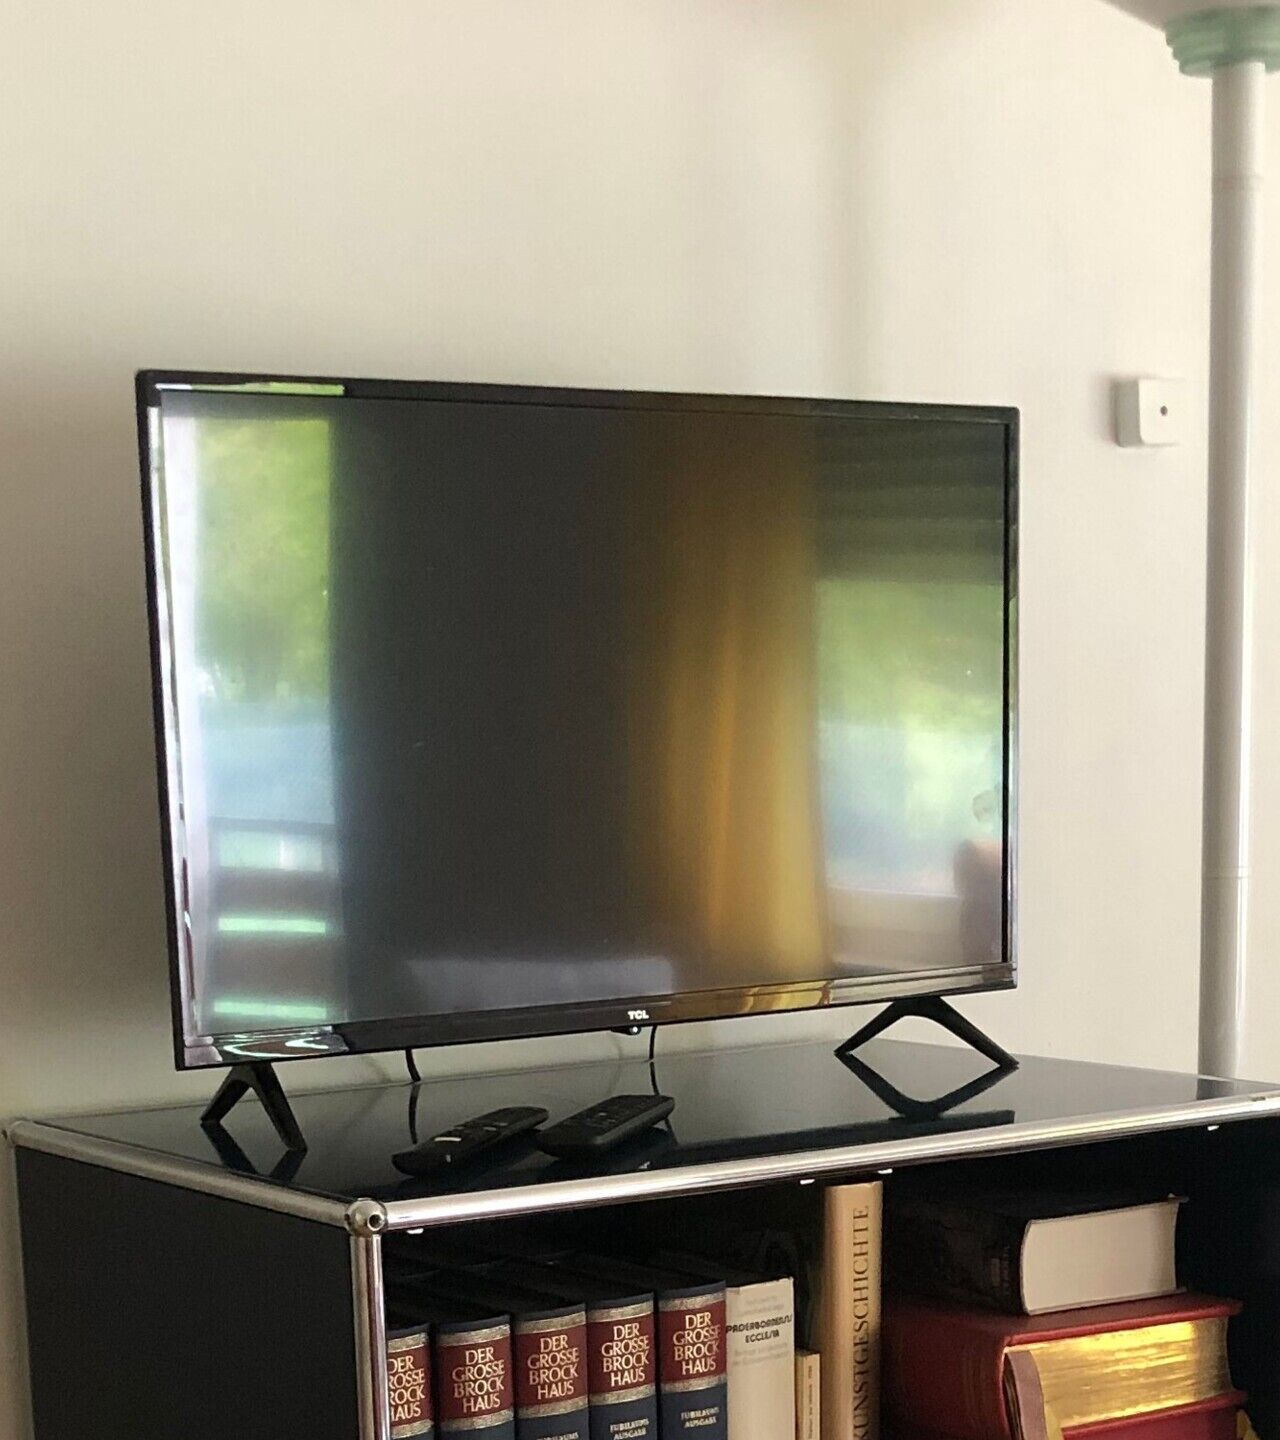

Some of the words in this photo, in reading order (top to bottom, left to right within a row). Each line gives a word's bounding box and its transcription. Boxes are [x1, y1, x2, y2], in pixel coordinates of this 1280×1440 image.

[627, 1010, 649, 1020] TCL
[684, 1311, 712, 1330] DER
[613, 1322, 640, 1340] DER
[672, 1325, 720, 1346] GROSSE
[540, 1334, 568, 1353] DER
[601, 1335, 650, 1357] GROSSE
[673, 1340, 719, 1361] BROCK
[388, 1355, 415, 1374] DER
[465, 1346, 495, 1366] DER
[527, 1347, 580, 1369] GROSSE
[602, 1350, 649, 1373] BROCK
[681, 1356, 717, 1375] HAUS
[389, 1368, 426, 1389] ROSSE
[451, 1359, 506, 1382] GROSSE
[528, 1363, 579, 1385] BROCK
[610, 1367, 646, 1387] HAUS
[389, 1385, 425, 1405] ROCK
[453, 1376, 505, 1398] BROCK
[537, 1380, 574, 1400] HAUS
[463, 1393, 501, 1413] HAUS
